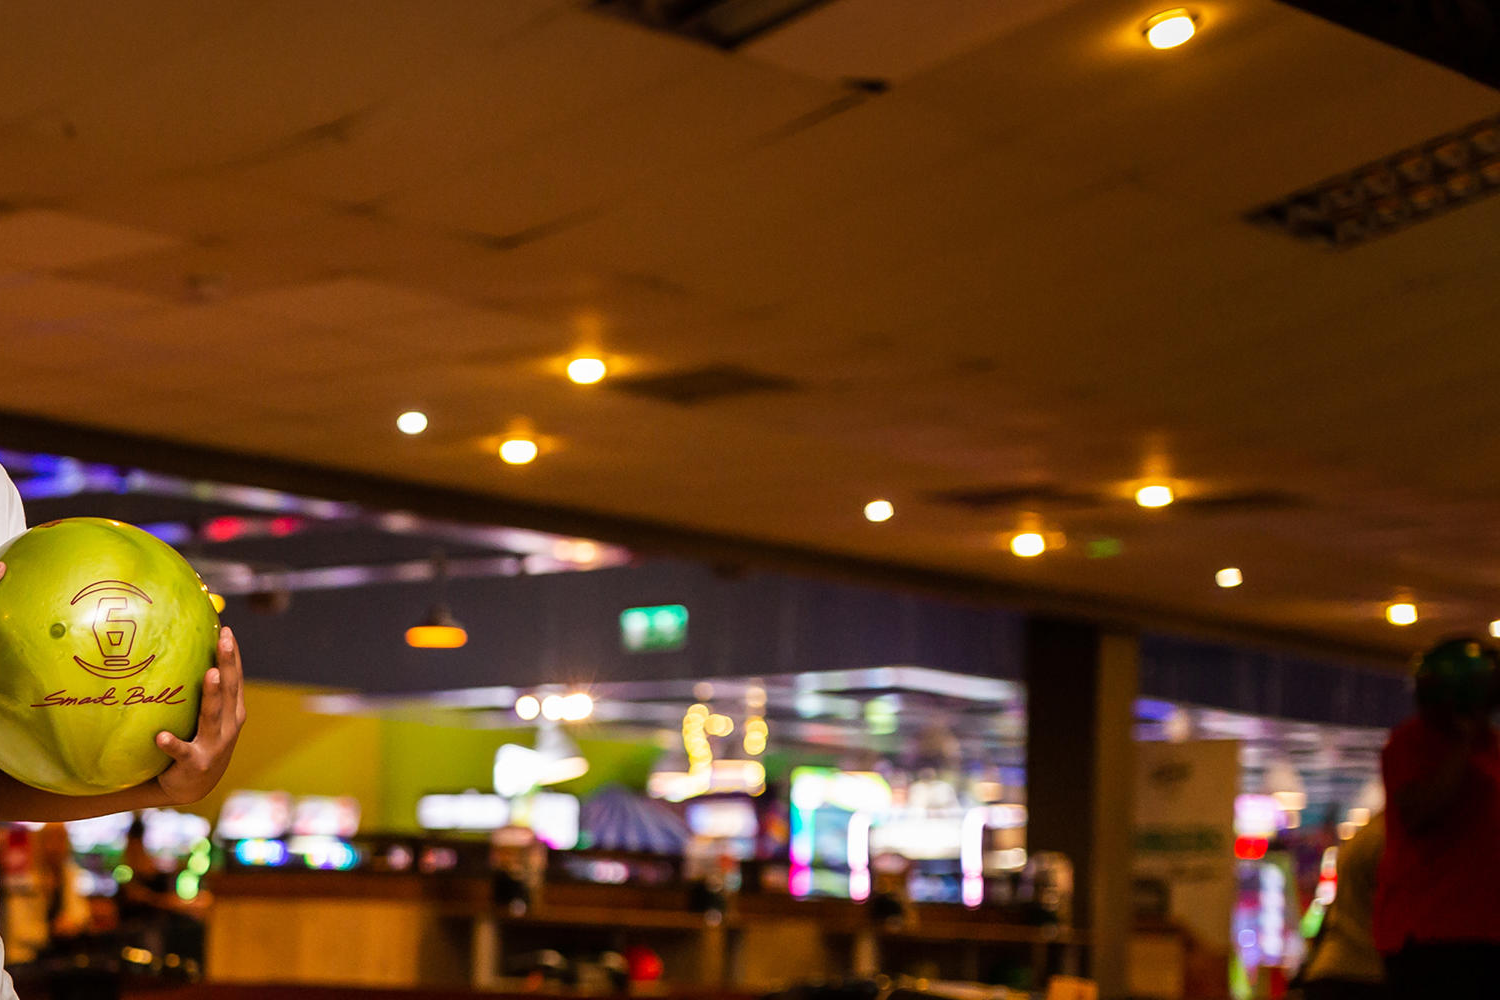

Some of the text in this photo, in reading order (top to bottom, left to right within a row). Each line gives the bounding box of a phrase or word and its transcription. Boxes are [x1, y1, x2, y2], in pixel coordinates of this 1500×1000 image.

[92, 596, 137, 658] 6
[30, 685, 187, 707] Smart Ball
